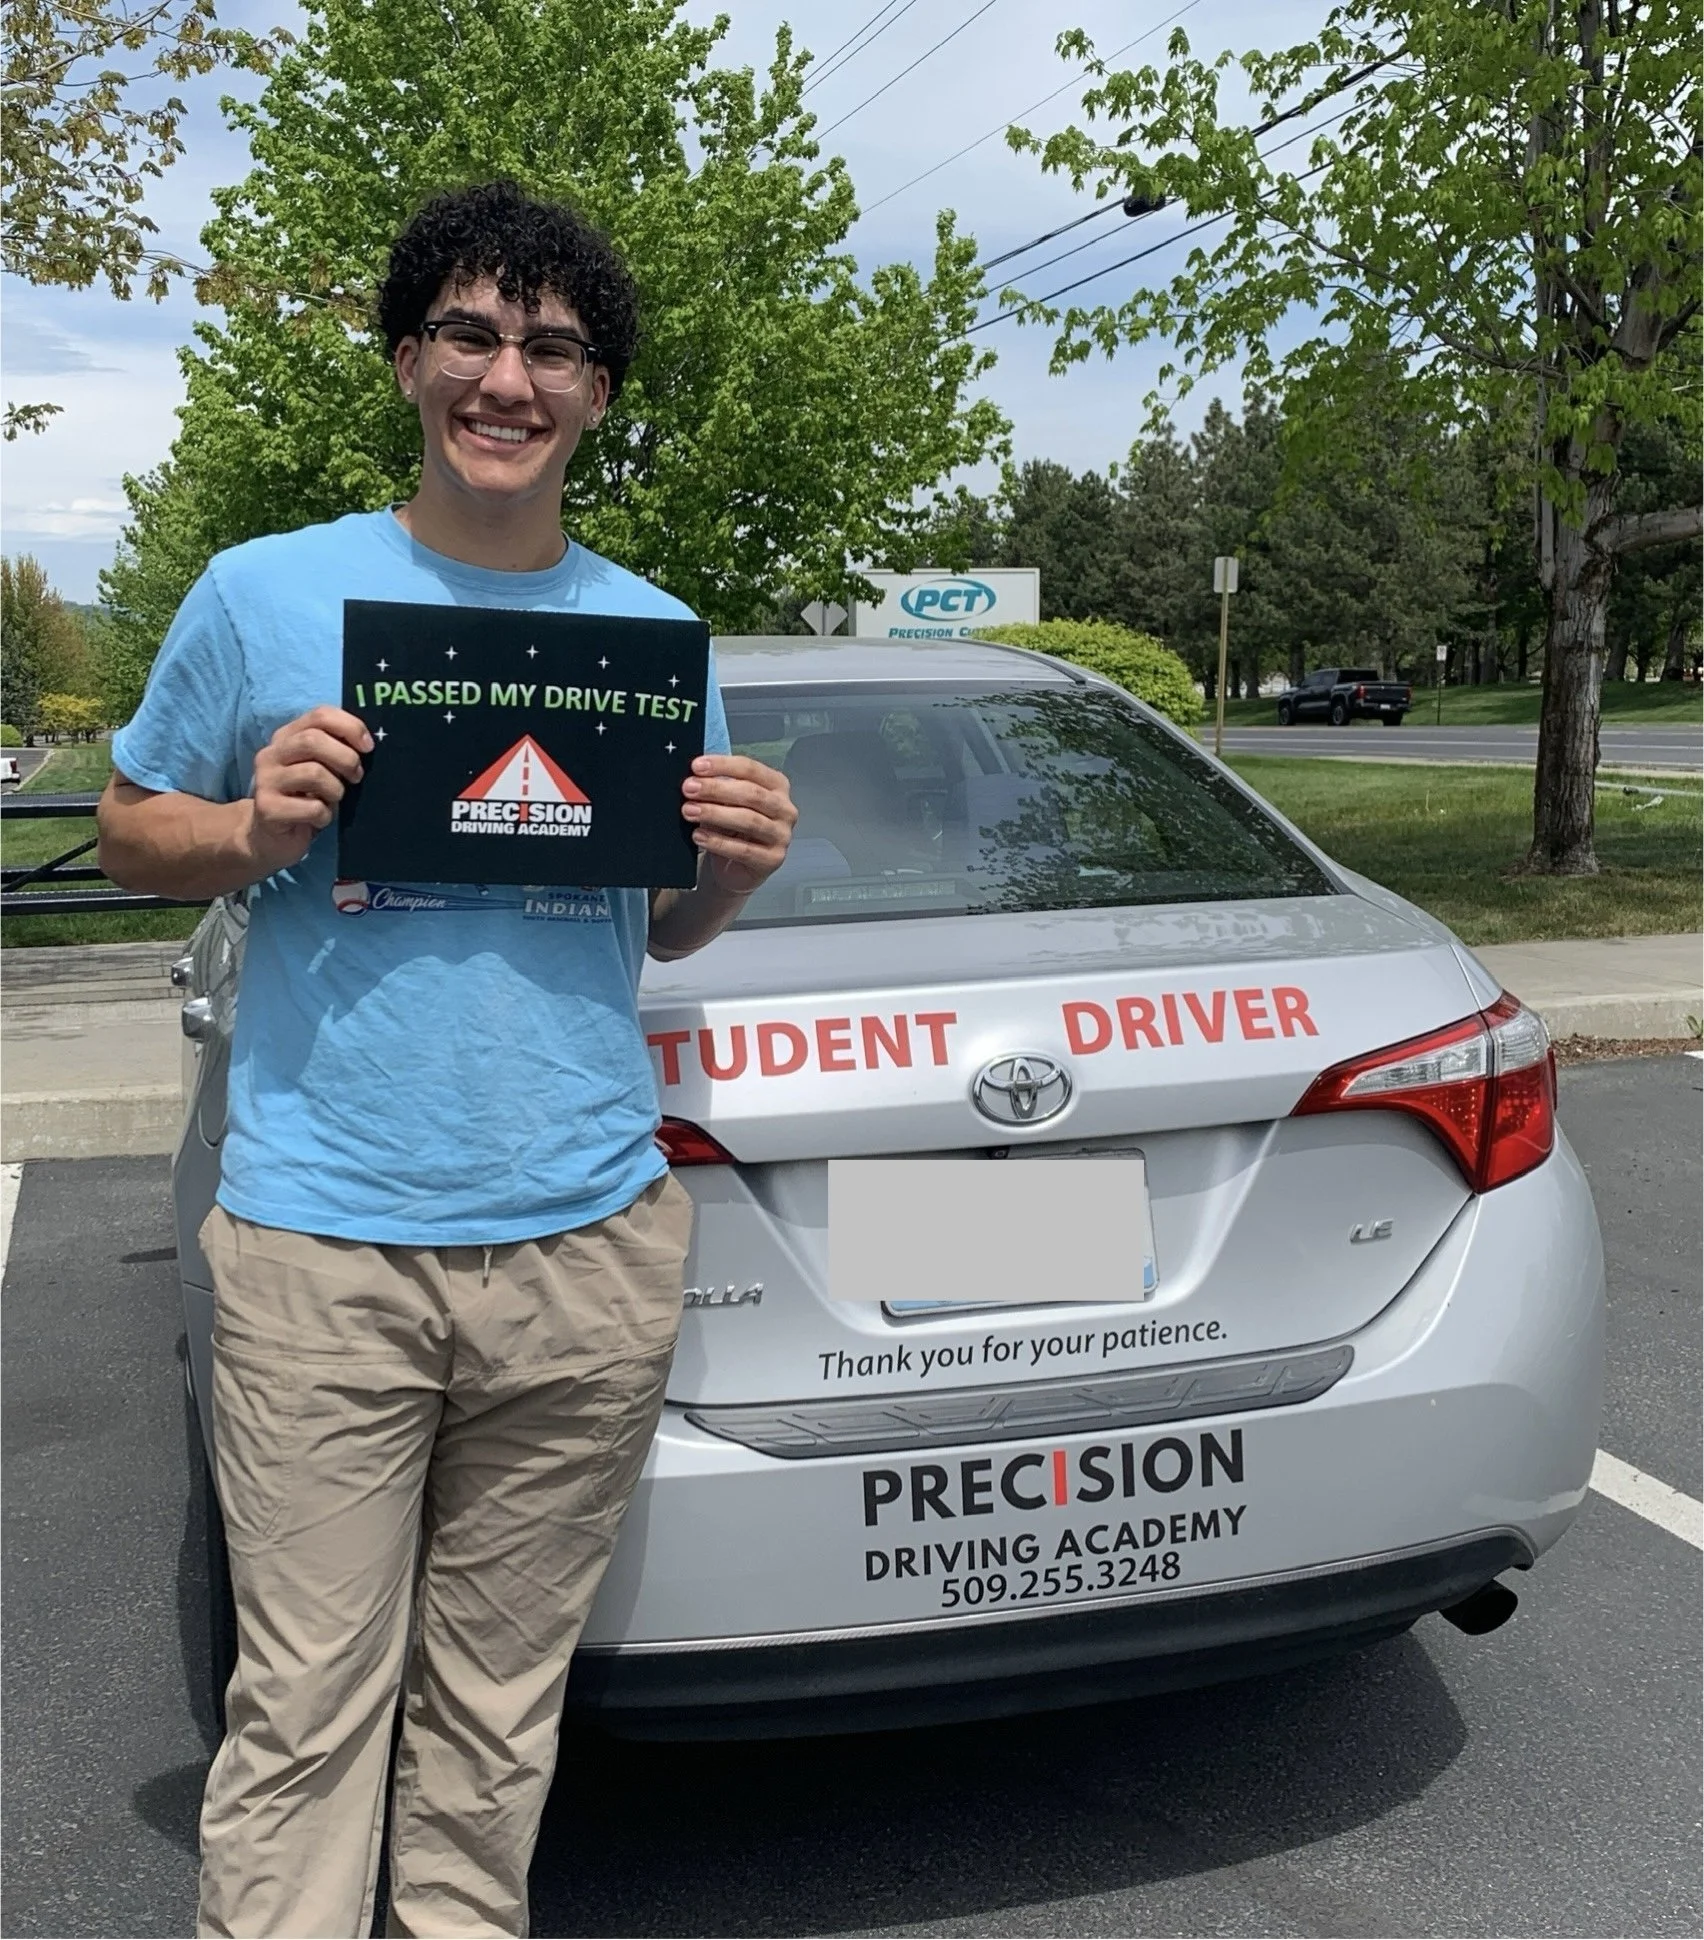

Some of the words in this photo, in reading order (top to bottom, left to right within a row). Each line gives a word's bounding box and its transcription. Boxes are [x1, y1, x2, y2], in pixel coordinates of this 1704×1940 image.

[914, 589, 985, 612] PCT
[888, 628, 954, 639] PRECISION
[355, 684, 366, 708] I
[374, 680, 482, 706] PASSED
[490, 683, 537, 707] MY
[544, 685, 626, 714] DRIVE
[635, 693, 698, 723] TEST
[451, 800, 592, 824] PRECISION
[451, 821, 515, 835] DRIVING
[517, 822, 591, 837] ACADEMY
[372, 888, 446, 912] Champion
[524, 899, 609, 917] INDIAN
[647, 1011, 957, 1085] TUDENT
[1062, 986, 1319, 1055] DRIVER
[682, 1282, 764, 1309] OLLA
[818, 1344, 912, 1381] Thank
[919, 1344, 973, 1377] you
[982, 1335, 1024, 1362] for
[1030, 1331, 1095, 1366] your
[1101, 1319, 1228, 1358] patience.
[862, 1429, 1244, 1527] PRECISION
[865, 1533, 1040, 1581] DRIVING
[1055, 1505, 1247, 1560] ACADEMY
[941, 1551, 1181, 1607] 509.255.3248
